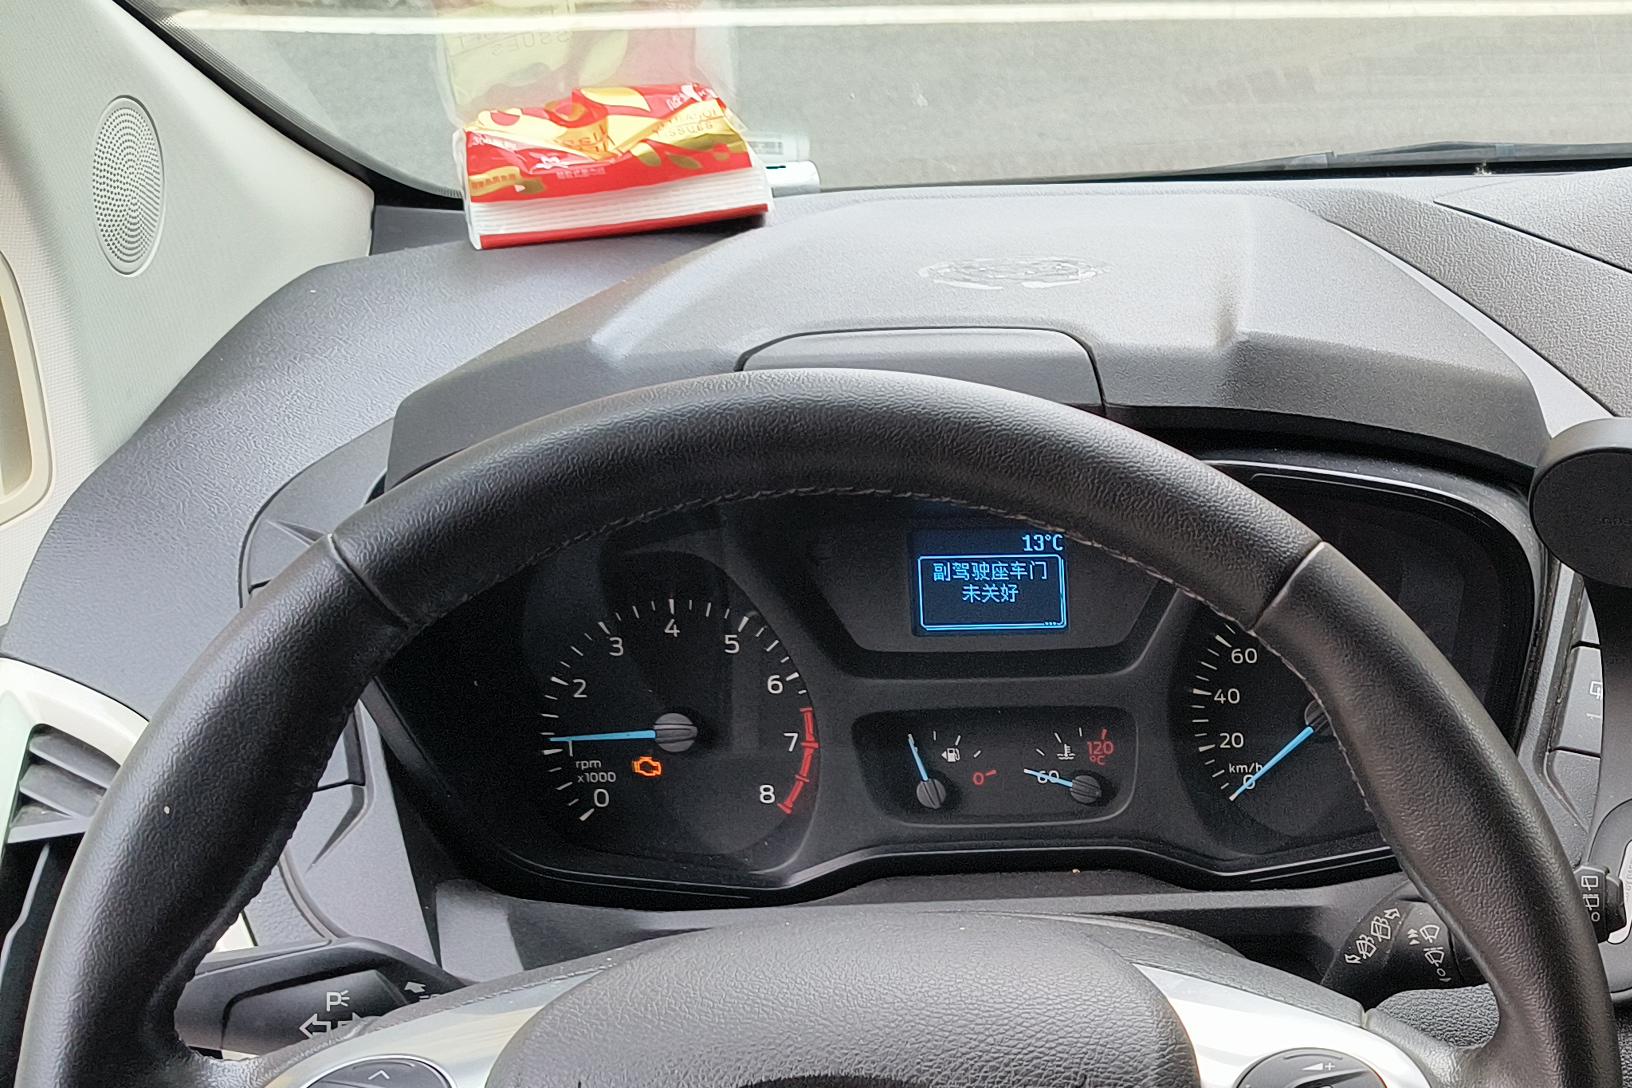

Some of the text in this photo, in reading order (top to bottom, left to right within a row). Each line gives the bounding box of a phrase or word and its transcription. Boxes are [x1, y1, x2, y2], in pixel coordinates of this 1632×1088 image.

[1022, 534, 1064, 551] 13°C
[933, 561, 1047, 582] 副驾驶座车门
[962, 583, 1019, 603] 未关好
[664, 619, 680, 637] 4
[609, 637, 624, 656] 3
[724, 634, 740, 654] 5
[1231, 648, 1258, 664] 60
[573, 679, 587, 698] 2
[767, 674, 783, 694] 6
[1213, 688, 1240, 704] 40
[783, 733, 798, 751] 7
[1087, 740, 1114, 755] 120
[1219, 733, 1244, 748] 20
[575, 760, 601, 770] rpm
[1228, 763, 1263, 774] km/h
[577, 772, 616, 783] x1000
[973, 773, 985, 786] 0
[594, 789, 609, 807] 0
[759, 784, 775, 803] 8
